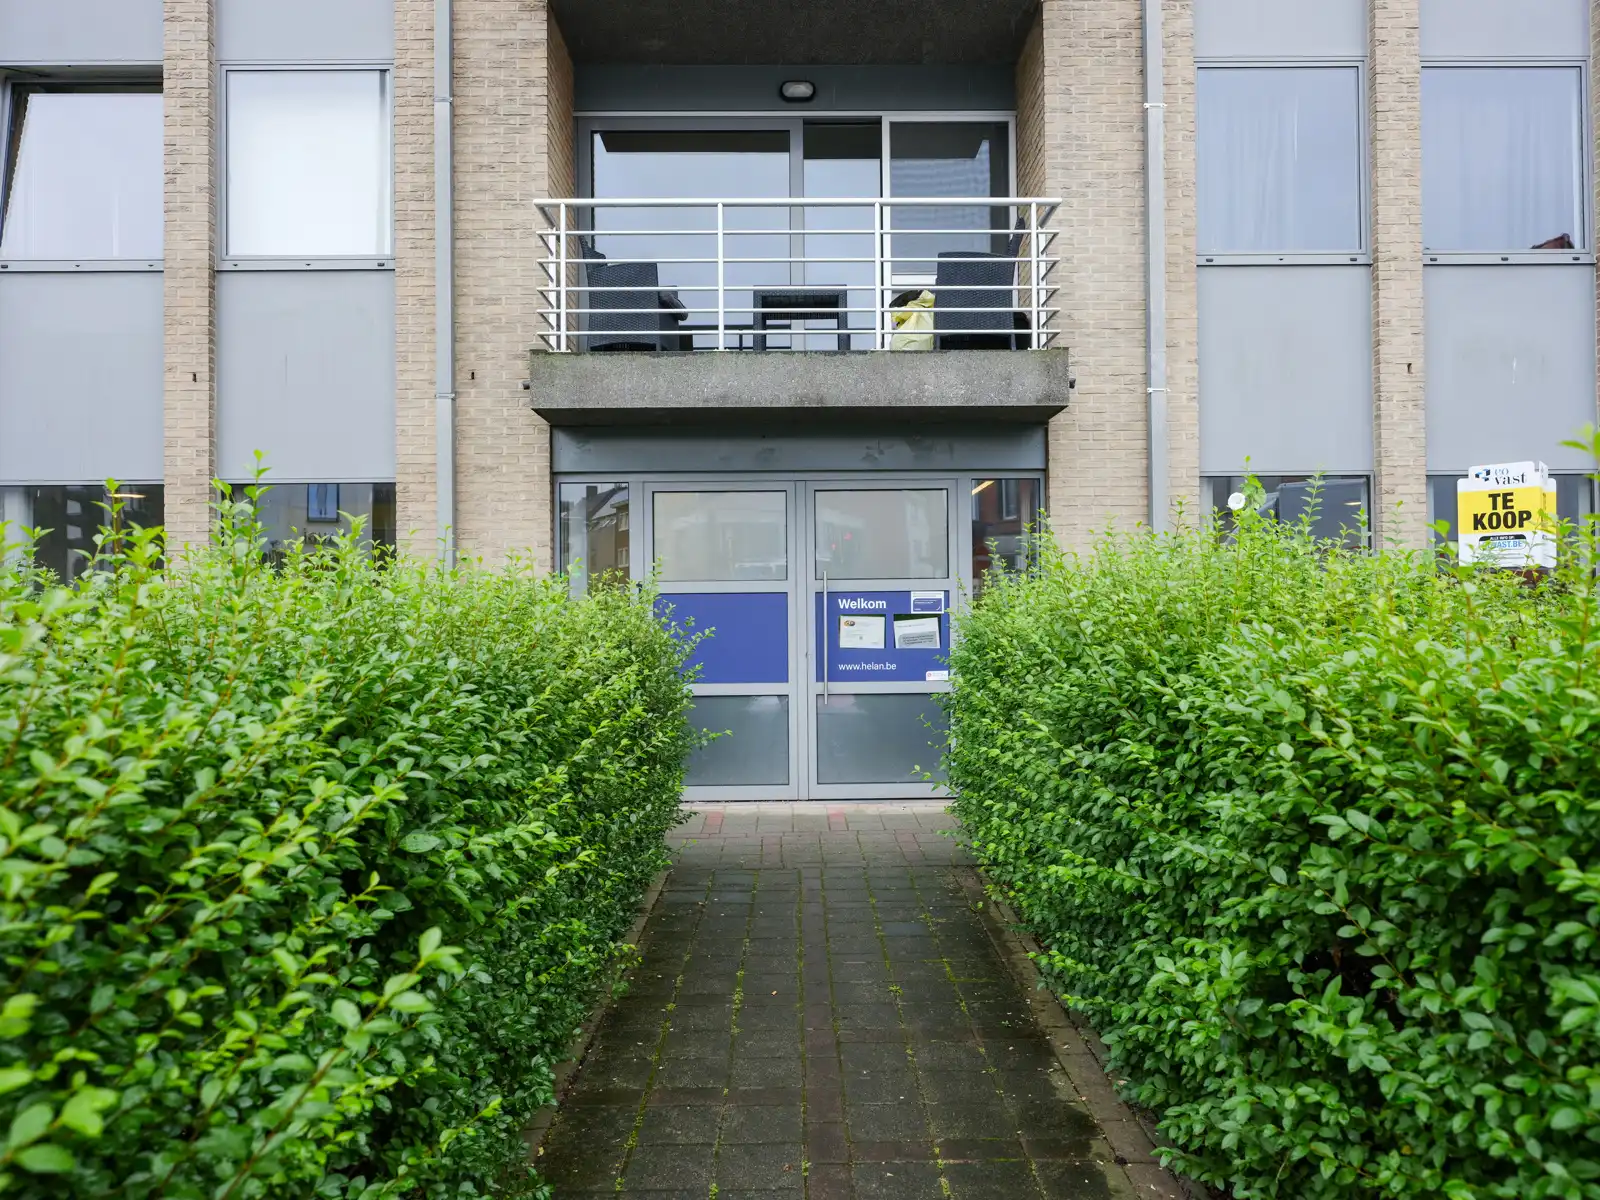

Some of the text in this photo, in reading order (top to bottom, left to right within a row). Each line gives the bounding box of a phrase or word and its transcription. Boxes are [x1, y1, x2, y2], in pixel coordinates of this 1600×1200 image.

[1494, 472, 1526, 485] vast
[1488, 492, 1514, 510] TE
[1473, 510, 1532, 530] KOOP
[1482, 540, 1523, 549] VAST.BE
[838, 598, 887, 609] Welkom
[838, 662, 897, 671] www.helan.be
